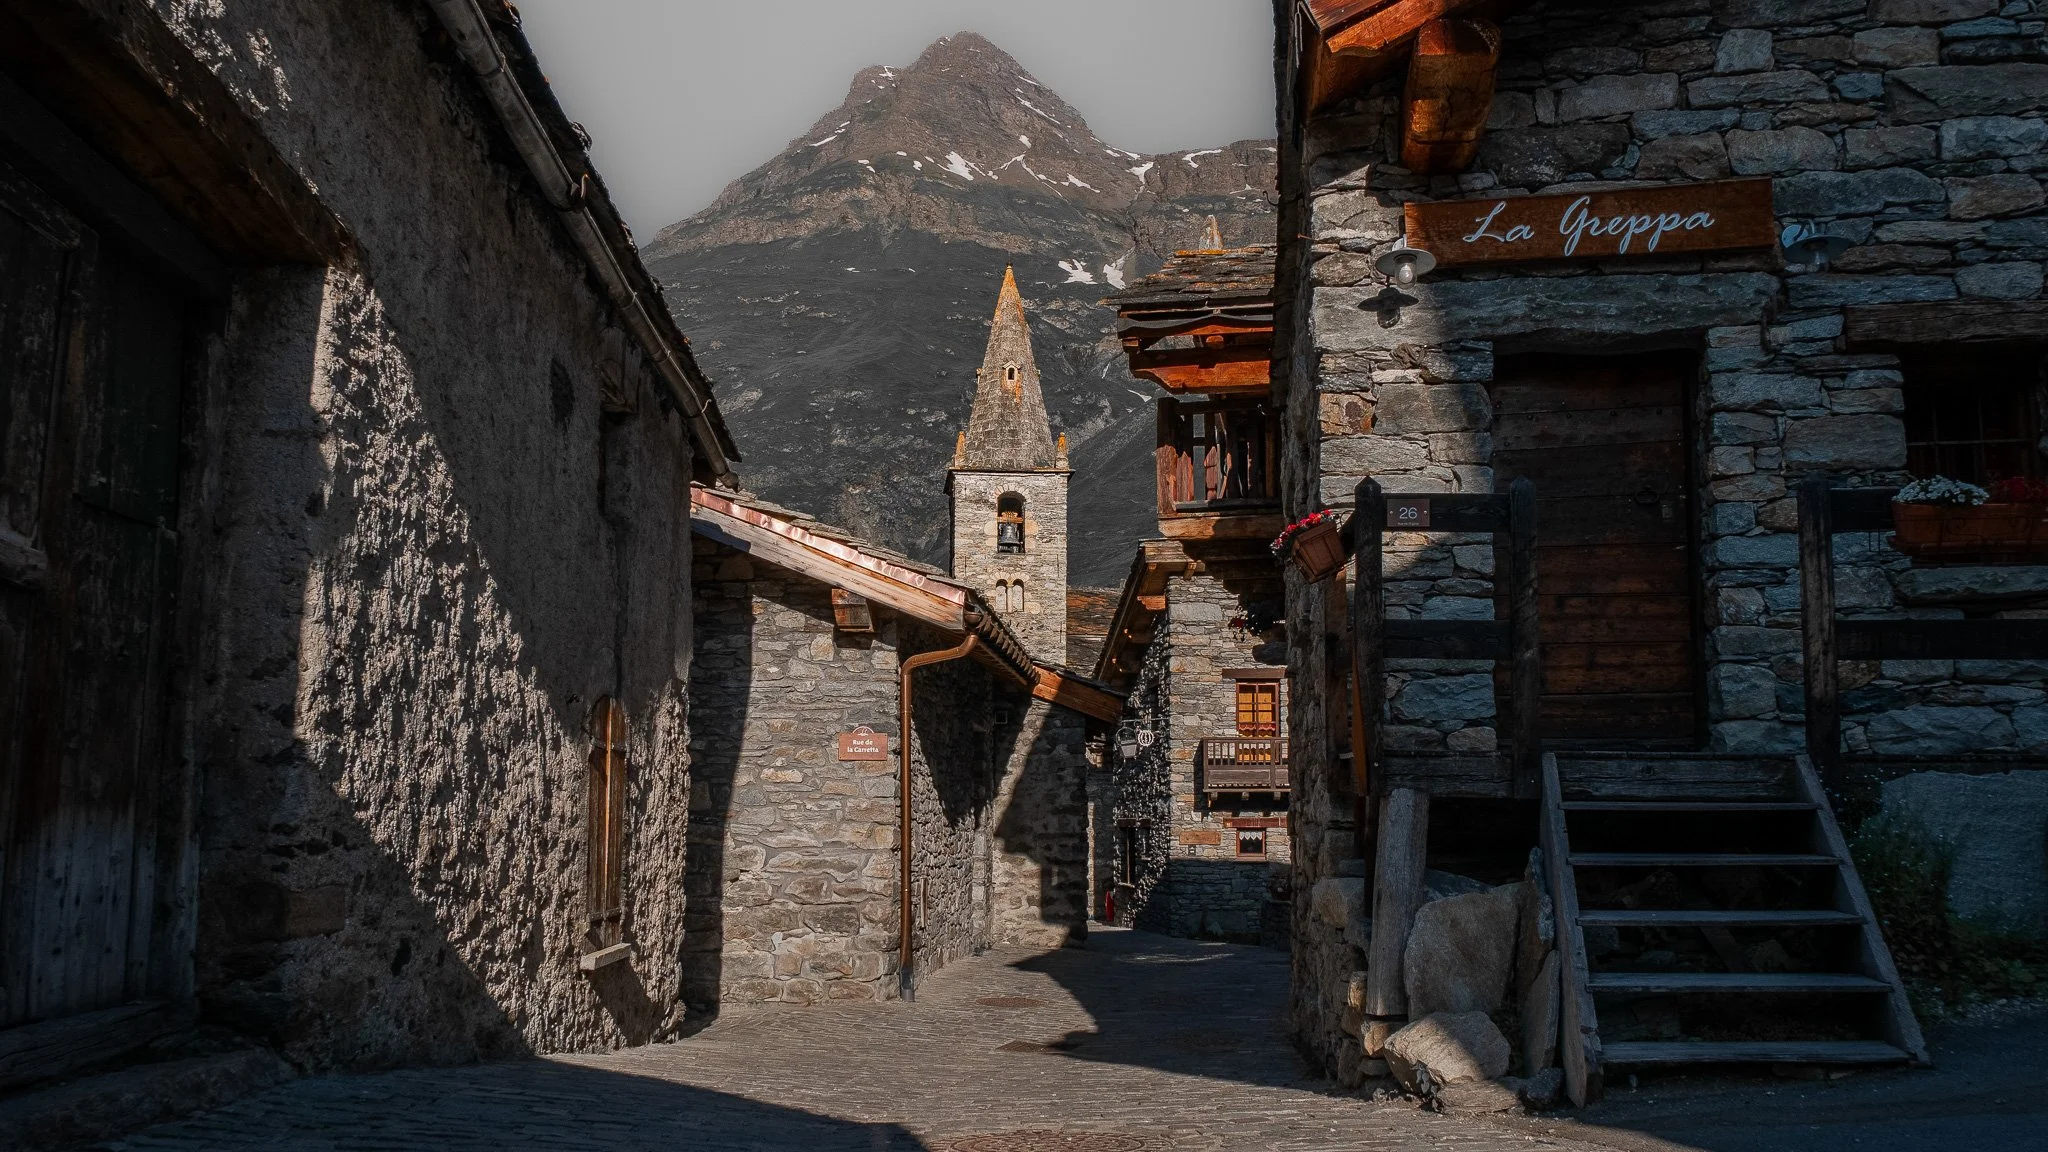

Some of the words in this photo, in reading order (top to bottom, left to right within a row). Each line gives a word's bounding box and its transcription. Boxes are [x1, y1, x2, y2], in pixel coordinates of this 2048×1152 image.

[1462, 201, 1535, 242] La
[1559, 195, 1715, 256] Greppa
[1399, 507, 1418, 519] 26
